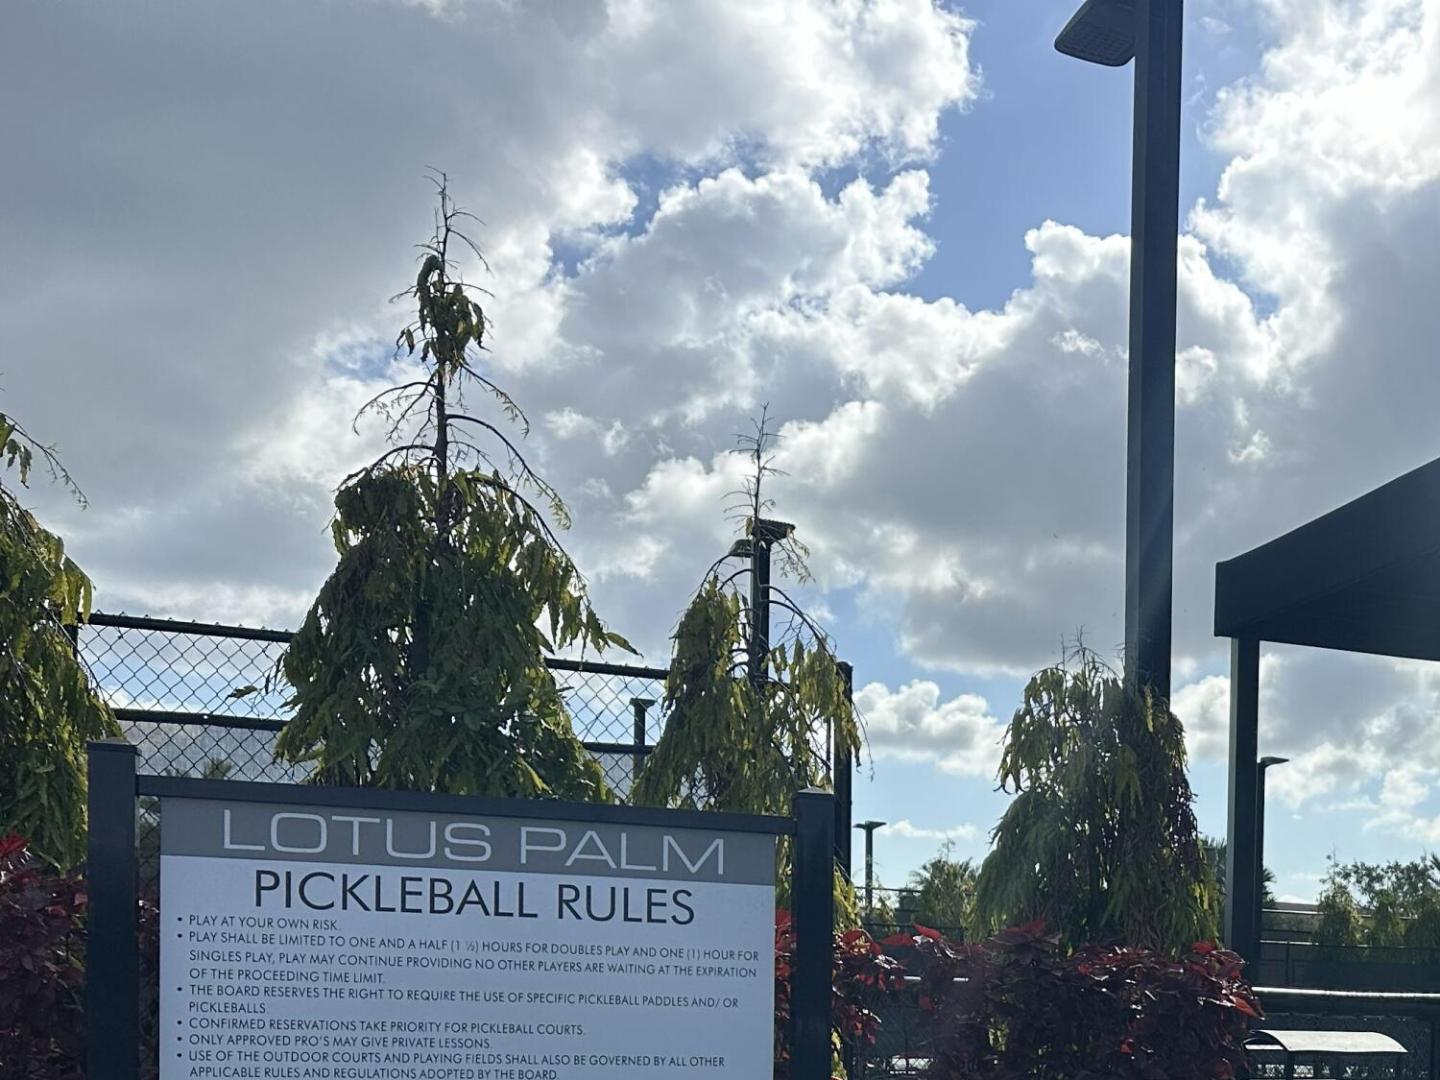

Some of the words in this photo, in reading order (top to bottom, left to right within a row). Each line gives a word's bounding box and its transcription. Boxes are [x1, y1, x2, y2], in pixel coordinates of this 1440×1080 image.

[223, 809, 492, 861] LOTUS
[519, 826, 724, 874] PALM
[255, 869, 538, 918] PICKLEBALL
[557, 883, 694, 925] RULES
[188, 914, 218, 926] PLAY
[219, 915, 235, 926] AT
[237, 915, 274, 928] YOUR
[276, 917, 309, 929] OWN
[188, 949, 242, 962] SINGLES
[244, 951, 275, 964] PLAY,
[278, 952, 306, 963] PLAY
[309, 953, 335, 964] MAY
[337, 953, 404, 967] CONTINUE
[405, 956, 472, 969] PROVIDING
[474, 958, 495, 969] NO
[496, 959, 535, 971] OTHER
[537, 960, 582, 972] PLAYERS
[583, 962, 604, 973] ARE
[606, 962, 655, 974] WAITING
[657, 964, 670, 974] AT
[672, 965, 693, 976] THE
[695, 965, 757, 978] EXPIRATION
[188, 967, 207, 979] OF
[209, 968, 234, 979] THE
[237, 968, 320, 982] PROCEEDING
[321, 971, 350, 983] TIME
[188, 1016, 266, 1029] CONFIRMED
[268, 1018, 357, 1031] RESERVATIONS
[358, 1020, 387, 1031] TAKE
[389, 1020, 442, 1032] PRIORITY
[443, 1021, 468, 1033] FOR
[470, 1022, 534, 1034] PICKLEBALL
[188, 1033, 224, 1045] ONLY
[225, 1034, 291, 1046] APPROVED
[332, 1036, 358, 1046] MAY
[360, 1035, 388, 1047] GIVE
[391, 1036, 435, 1048] PRIVATE
[188, 1065, 261, 1077] APPLICABLE
[263, 1066, 300, 1078] RULES
[302, 1067, 330, 1078] AND
[333, 1067, 417, 1079] REGULATIONS
[418, 1068, 474, 1079] ADOPTED
[477, 1068, 491, 1079] BY
[493, 1068, 515, 1079] THE
